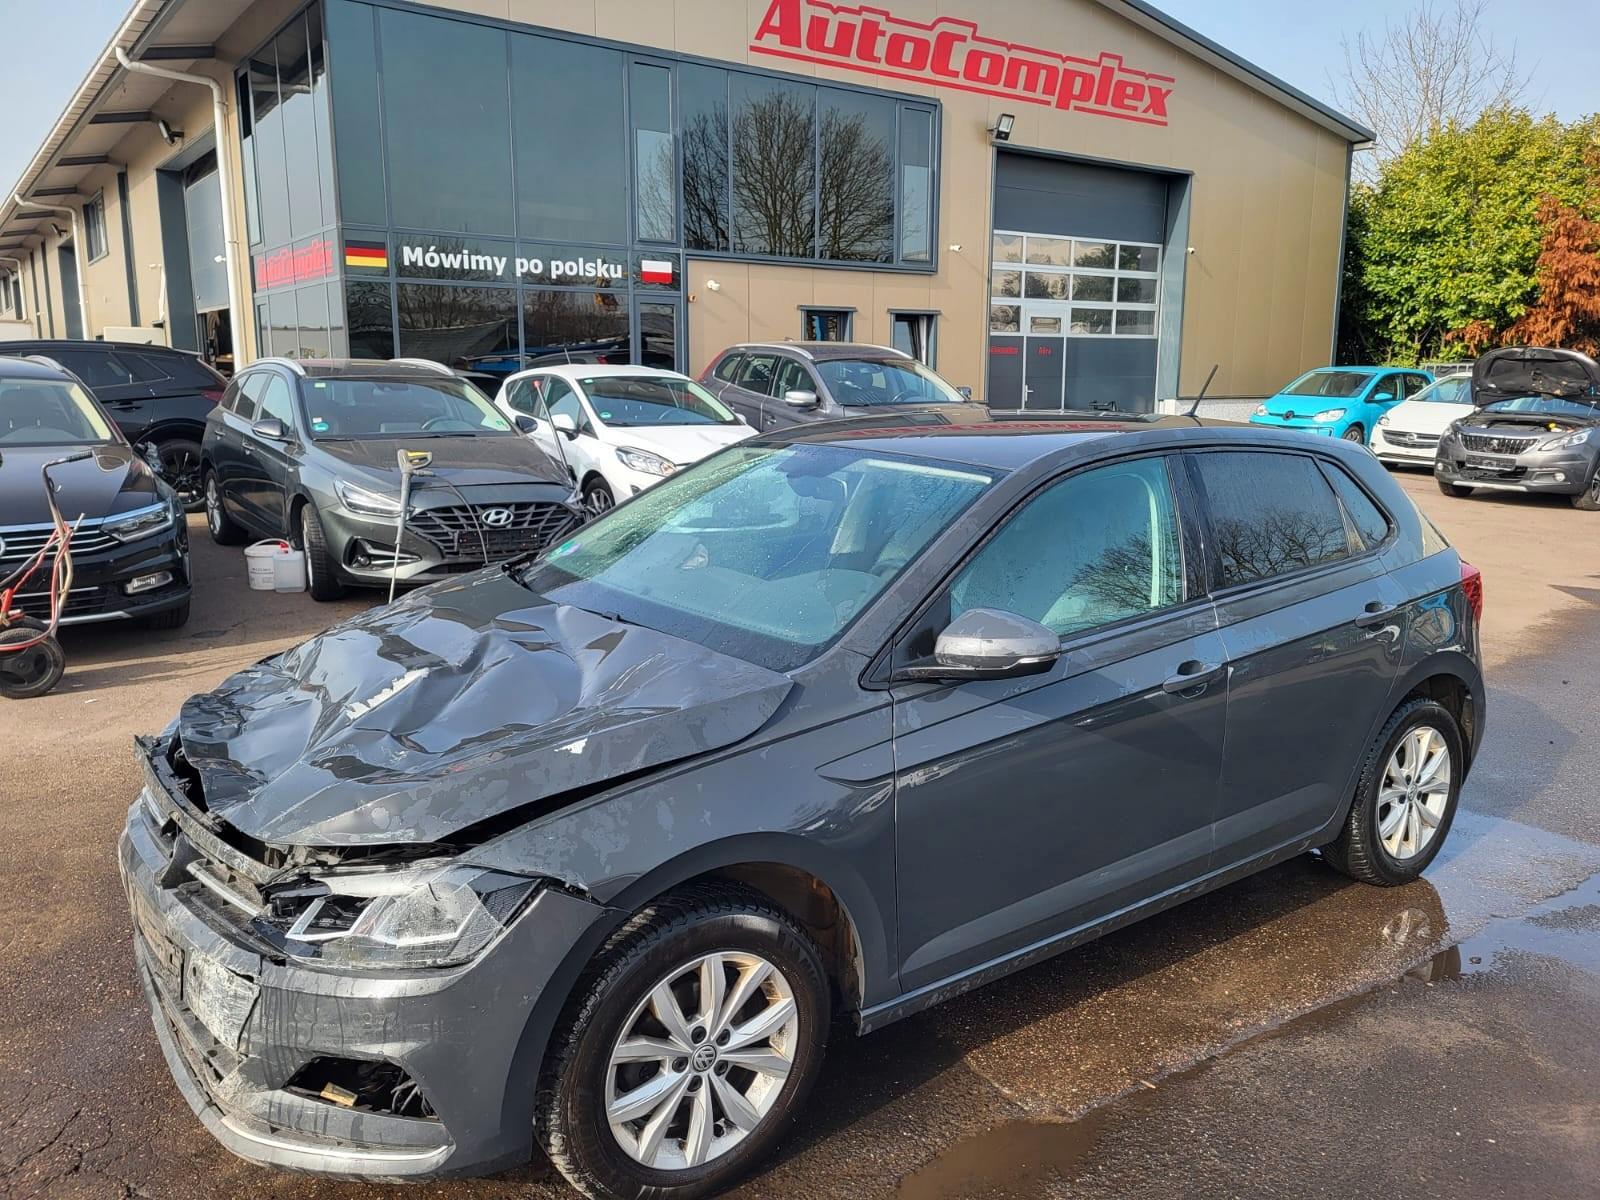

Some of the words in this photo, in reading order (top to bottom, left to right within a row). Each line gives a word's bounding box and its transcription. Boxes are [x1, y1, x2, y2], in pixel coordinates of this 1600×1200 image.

[753, 0, 1174, 120] AutoComplex
[402, 245, 507, 276] Mówimy
[515, 257, 544, 277] po
[550, 257, 623, 279] polsku
